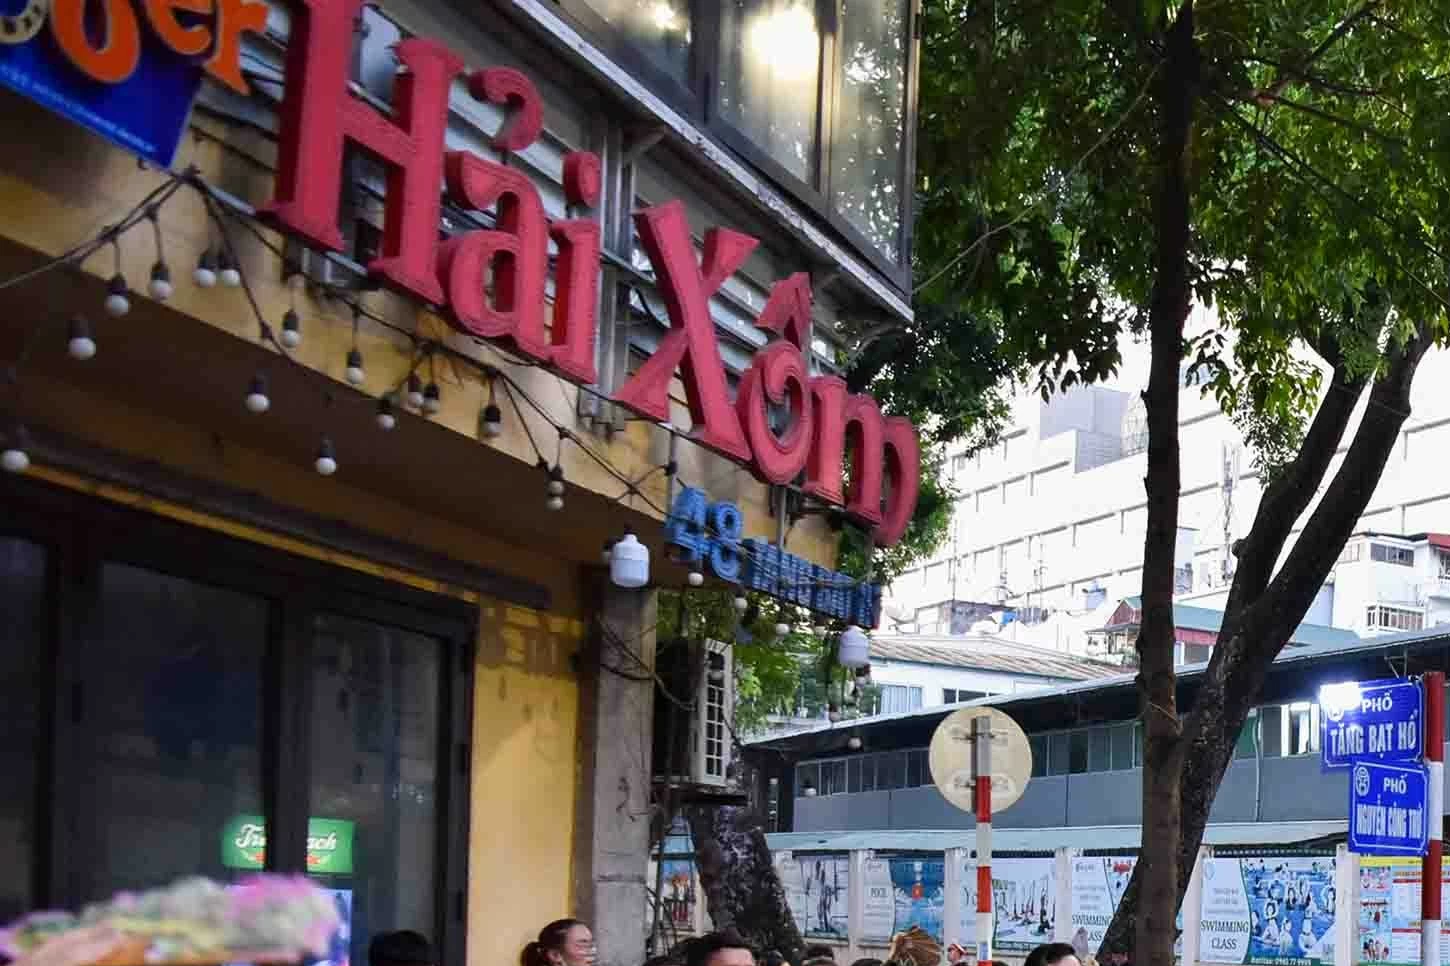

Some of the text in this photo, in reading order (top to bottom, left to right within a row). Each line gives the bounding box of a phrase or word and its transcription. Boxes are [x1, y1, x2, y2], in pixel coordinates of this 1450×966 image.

[1361, 689, 1393, 713] PHỐ
[1368, 722, 1394, 759] BẠT
[1383, 773, 1409, 795] PHỐ
[1200, 919, 1249, 933] SWIMMING
[1211, 937, 1238, 950] CLASS
